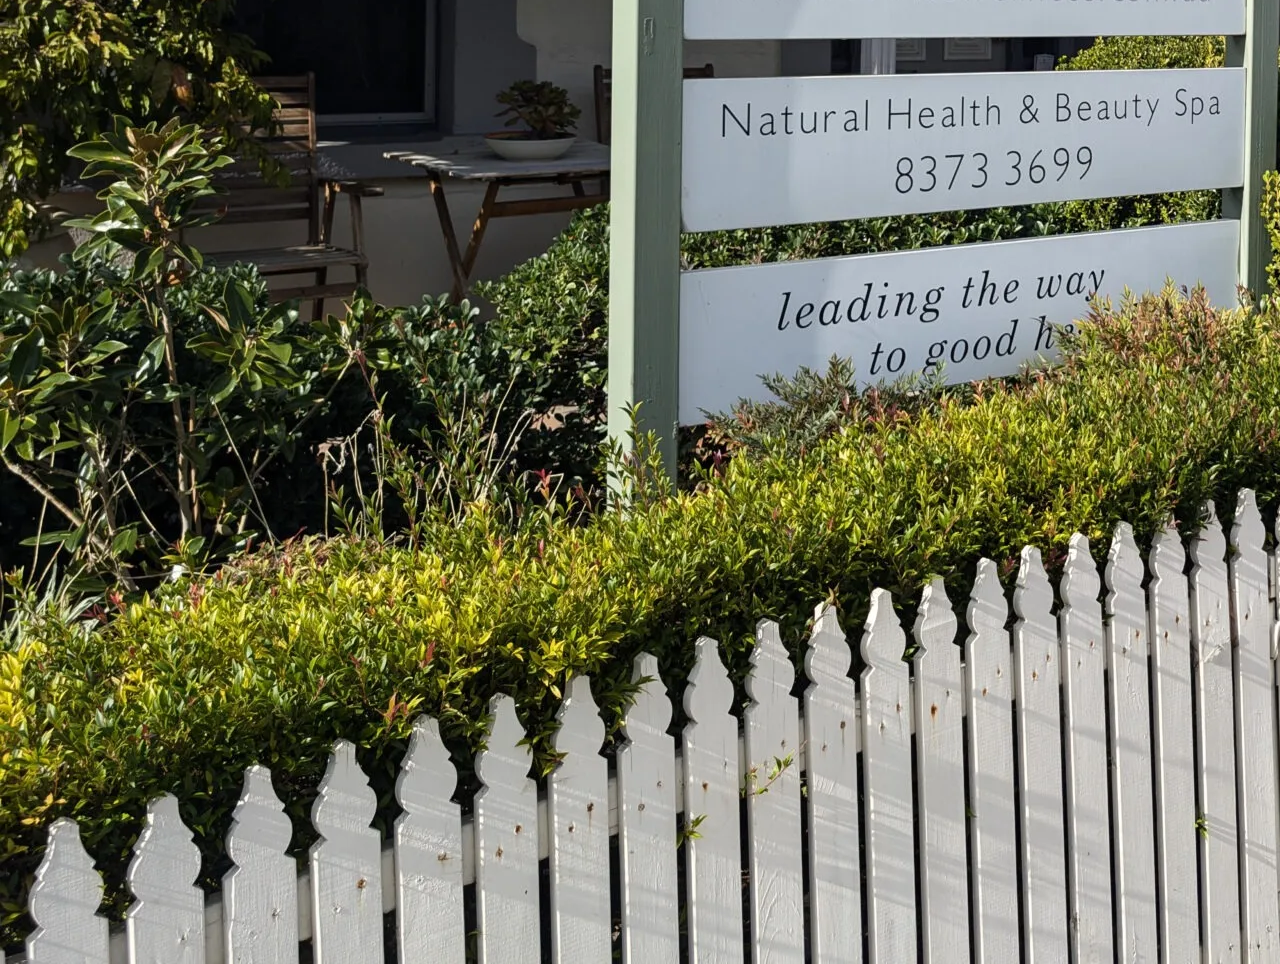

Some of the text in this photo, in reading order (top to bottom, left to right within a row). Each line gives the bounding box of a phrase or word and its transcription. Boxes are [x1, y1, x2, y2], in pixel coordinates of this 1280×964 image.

[721, 88, 1221, 137] Natural Health & Beauty Spa
[895, 146, 1093, 194] 8373 3699
[777, 269, 1105, 331] leading the way
[869, 342, 907, 375] to
[924, 319, 1019, 374] good
